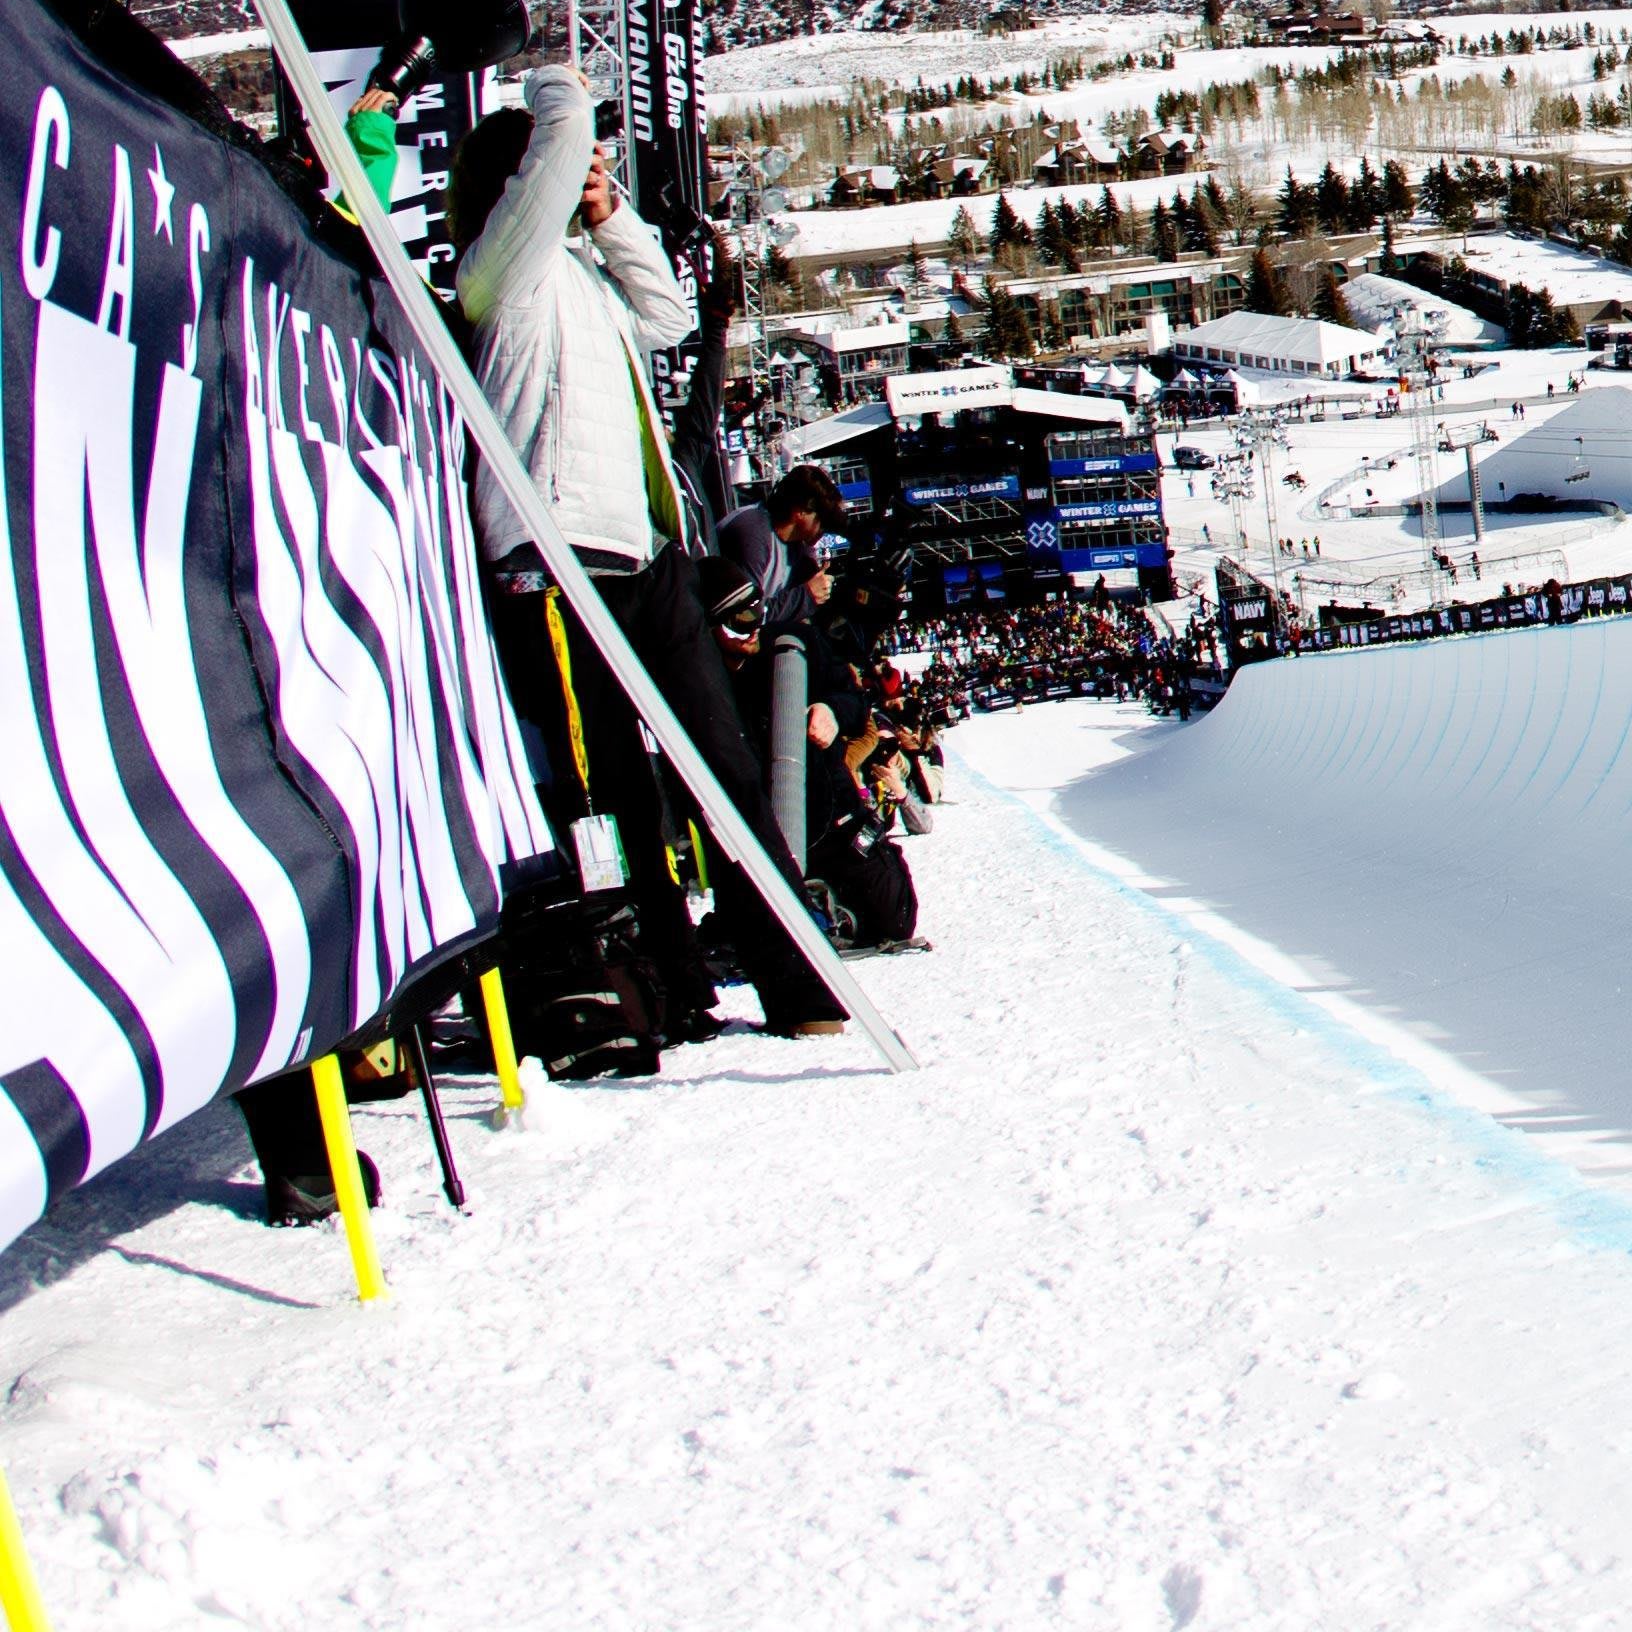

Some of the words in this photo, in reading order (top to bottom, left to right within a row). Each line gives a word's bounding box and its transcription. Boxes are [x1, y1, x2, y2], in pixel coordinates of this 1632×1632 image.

[901, 390, 939, 399] WINTER
[959, 382, 1000, 394] GAMES
[911, 486, 955, 500] WINTER
[970, 481, 1009, 494] GAMES
[1059, 506, 1103, 518] WINTER
[1117, 501, 1157, 514] GAMES
[1588, 585, 1605, 607] Jeep
[1608, 581, 1627, 605] Jeep
[1233, 602, 1266, 621] NAVY
